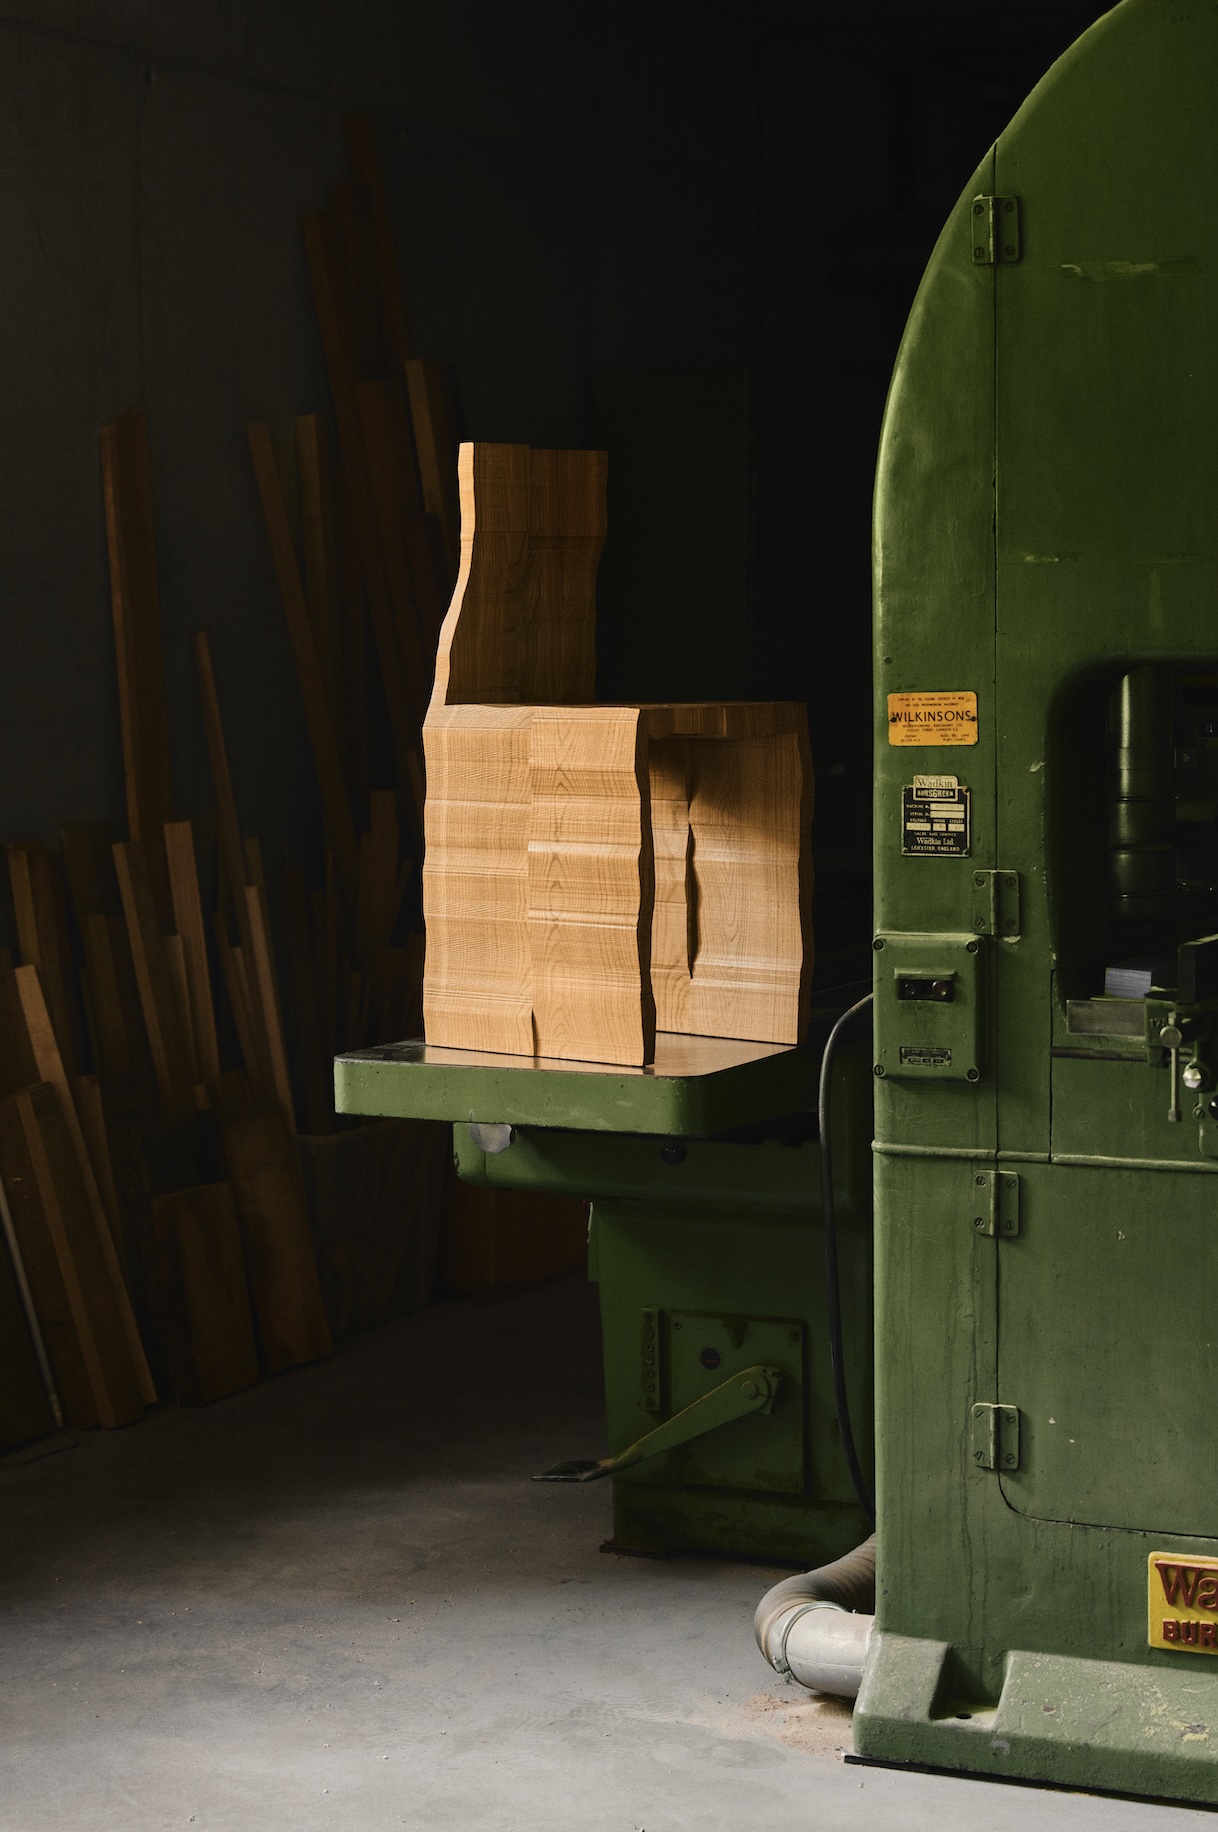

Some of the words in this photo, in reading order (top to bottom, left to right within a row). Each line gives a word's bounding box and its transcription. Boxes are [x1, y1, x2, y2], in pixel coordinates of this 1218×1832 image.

[891, 710, 972, 722] WILKINSONS
[917, 778, 954, 788] Wadkin
[916, 837, 942, 845] Wadkin
[1162, 1618, 1218, 1649] BUR
